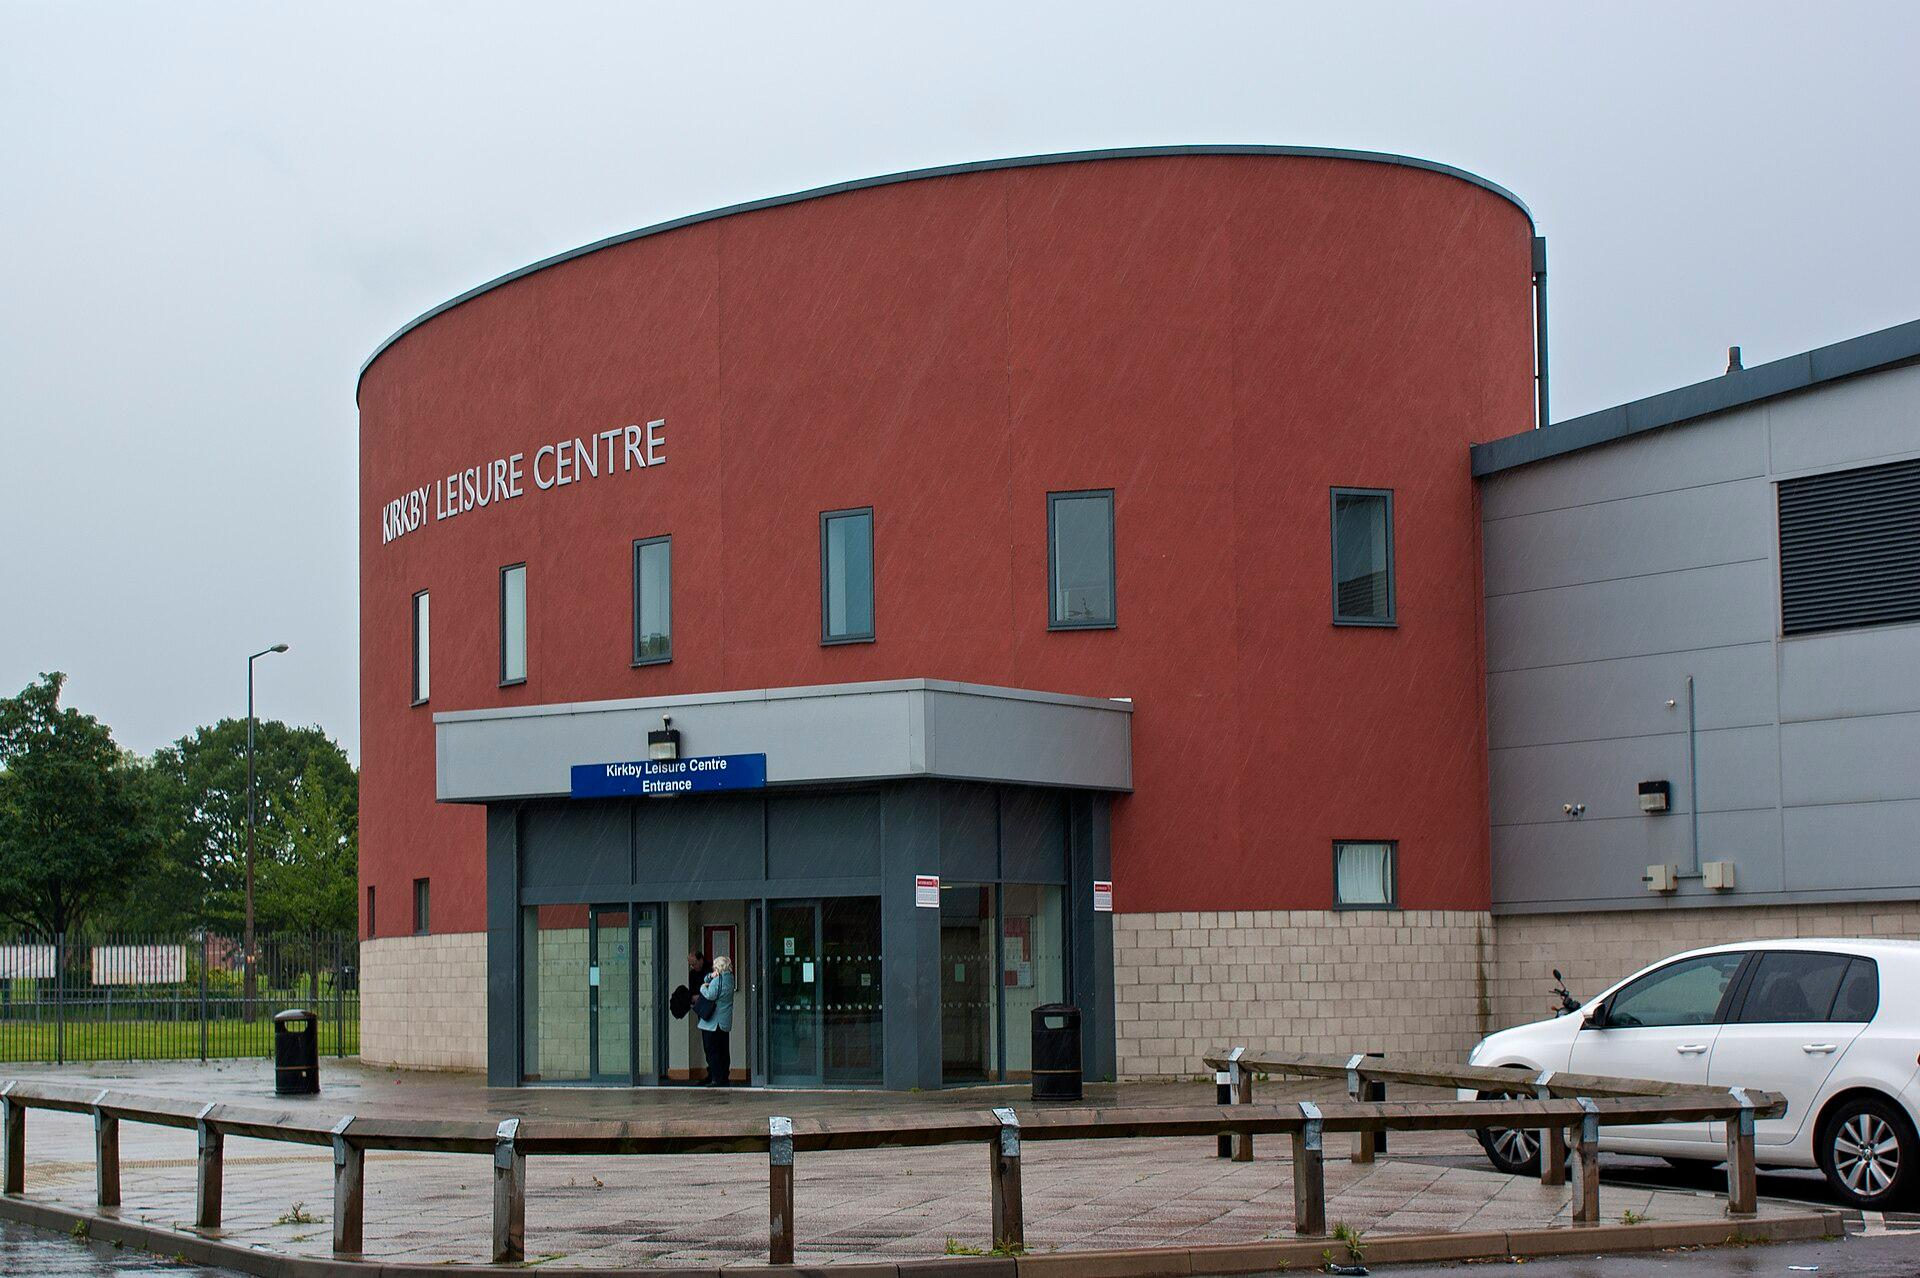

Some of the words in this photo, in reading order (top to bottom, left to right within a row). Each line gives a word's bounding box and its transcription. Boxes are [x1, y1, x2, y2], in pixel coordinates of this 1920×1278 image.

[382, 485, 430, 544] KIRKBY
[436, 453, 523, 520] LEISURE
[534, 419, 666, 490] CENTRE
[606, 763, 642, 778] Kirkby
[645, 762, 686, 775] Leisure
[689, 758, 727, 771] Centre
[642, 779, 692, 792] Entrance
